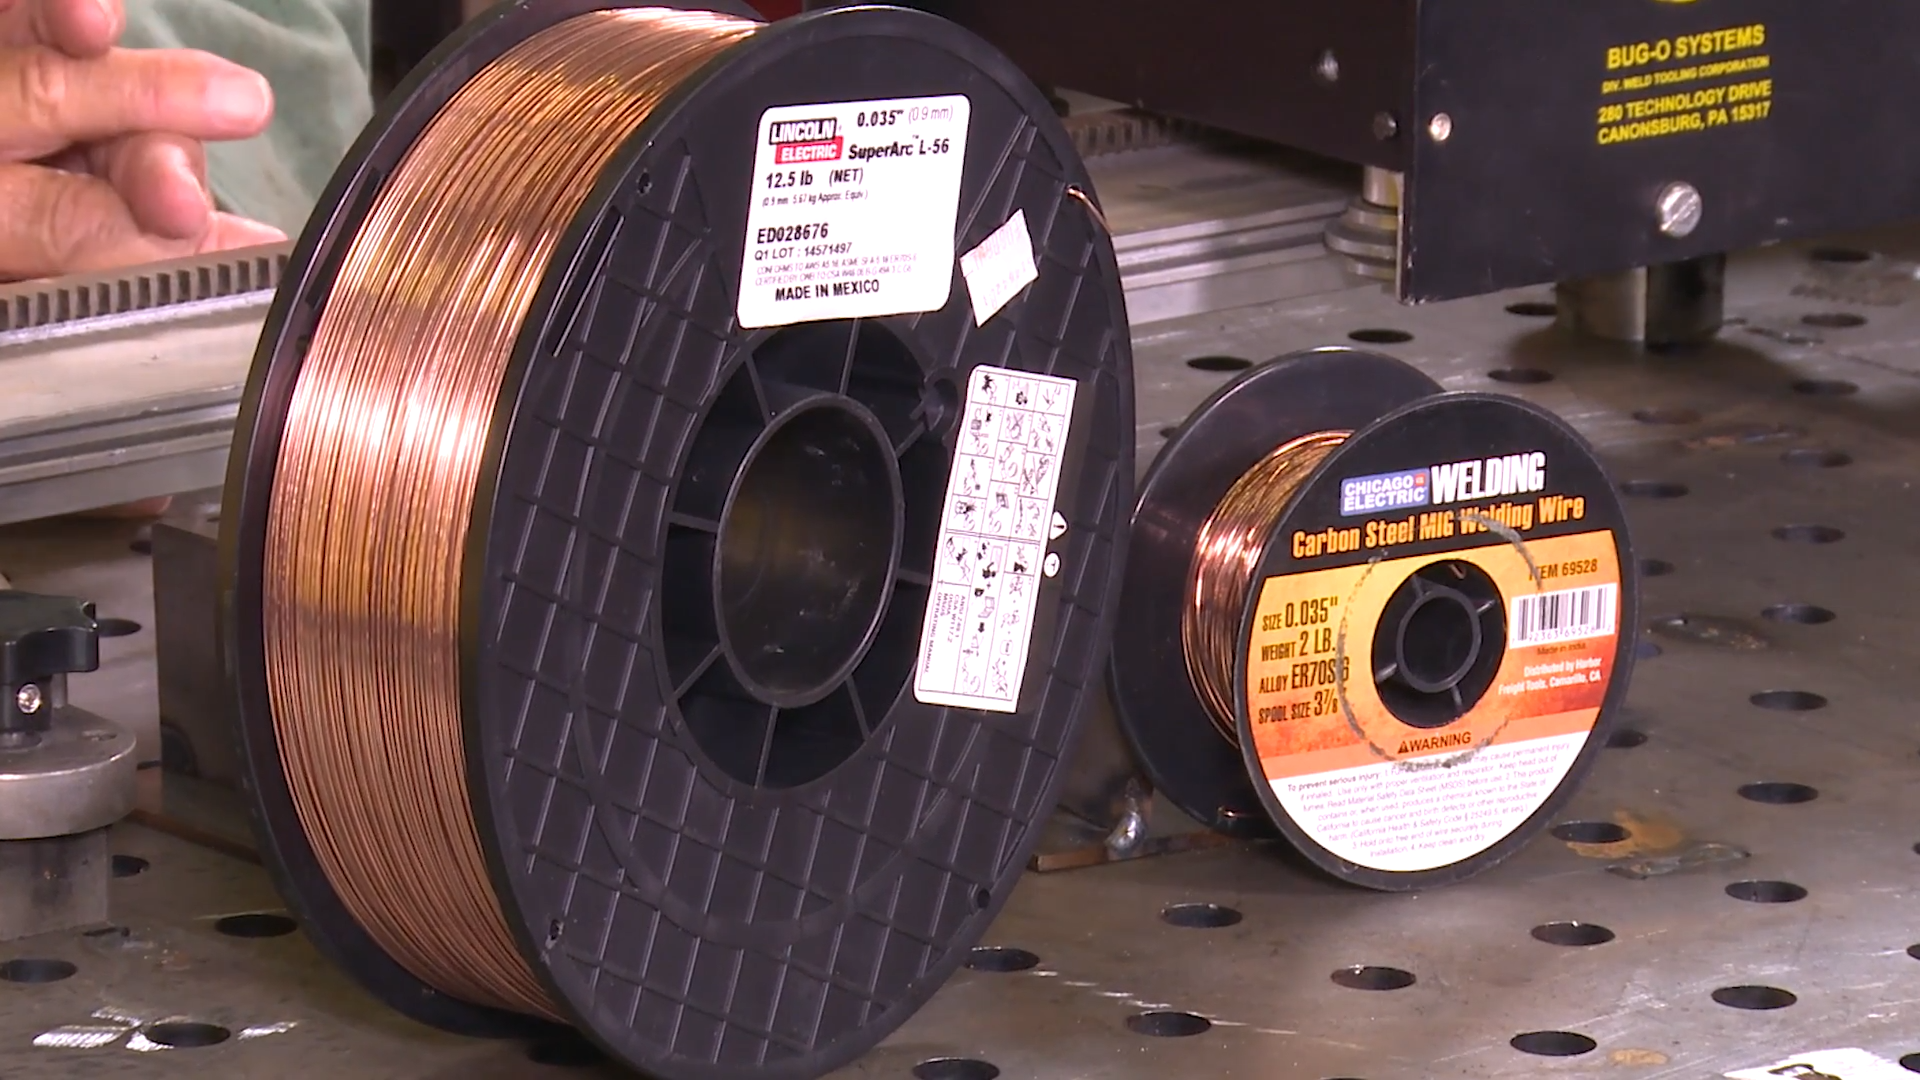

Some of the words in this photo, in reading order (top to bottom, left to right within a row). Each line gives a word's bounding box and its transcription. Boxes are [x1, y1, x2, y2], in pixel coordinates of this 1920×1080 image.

[1607, 39, 1671, 69] BUG-O
[1675, 24, 1765, 57] SYSTEMS
[1602, 79, 1622, 94] DIV.
[1624, 74, 1651, 90] WELD
[1654, 67, 1697, 86] TOOLING
[1699, 55, 1770, 77] CORPORATION
[930, 105, 953, 121] mm)
[1598, 104, 1623, 123] 280
[1626, 87, 1725, 119] TECHNOLOGY
[1728, 79, 1772, 101] DRIVE
[771, 119, 834, 143] LINCOLN
[1598, 113, 1705, 144] CANONSBURG,
[1708, 109, 1728, 126] PA
[1731, 101, 1771, 121] 15317
[781, 144, 837, 162] ELECTRIC
[918, 138, 950, 155] L-56
[766, 170, 796, 189] 12.5
[800, 170, 813, 186] lb
[828, 167, 864, 187] (NET)
[757, 223, 829, 244] ED028676
[754, 250, 769, 261] Q1
[772, 247, 794, 259] LOT
[804, 242, 852, 257] 14571497
[775, 285, 811, 301] MADE
[815, 283, 829, 298] IN
[833, 279, 880, 296] MEXICO
[1345, 475, 1414, 497] CHICAGO
[1431, 451, 1546, 504] WELDING
[1344, 487, 1425, 512] ELECTRIC
[1293, 527, 1361, 558] Carbon
[1365, 515, 1416, 548] Steel
[1419, 510, 1455, 539] MIG
[1460, 502, 1534, 535] Welding
[1538, 495, 1585, 524] Wire
[1561, 558, 1598, 577] 69528
[1262, 613, 1282, 632] SIZE
[1285, 596, 1338, 628] 0.035"
[1261, 641, 1296, 662] WEIGHT
[1299, 630, 1309, 657] 2
[1313, 627, 1336, 654] LB.
[1259, 674, 1289, 694] ALLOY
[1291, 656, 1350, 689] ER70S6
[1524, 661, 1564, 677] Distributed
[1566, 661, 1575, 673] by
[1575, 657, 1602, 669] Harbor
[1589, 669, 1601, 682] CA
[1259, 705, 1288, 725] SPOOL
[1291, 701, 1311, 720] SIZE
[1409, 731, 1471, 752] WARNING
[1298, 780, 1327, 792] prevent
[1329, 776, 1356, 786] serious
[1513, 745, 1549, 758] permanent
[1386, 780, 1407, 789] proper
[1519, 757, 1536, 766] head
[1348, 794, 1375, 805] Material
[1376, 792, 1398, 801] Safety
